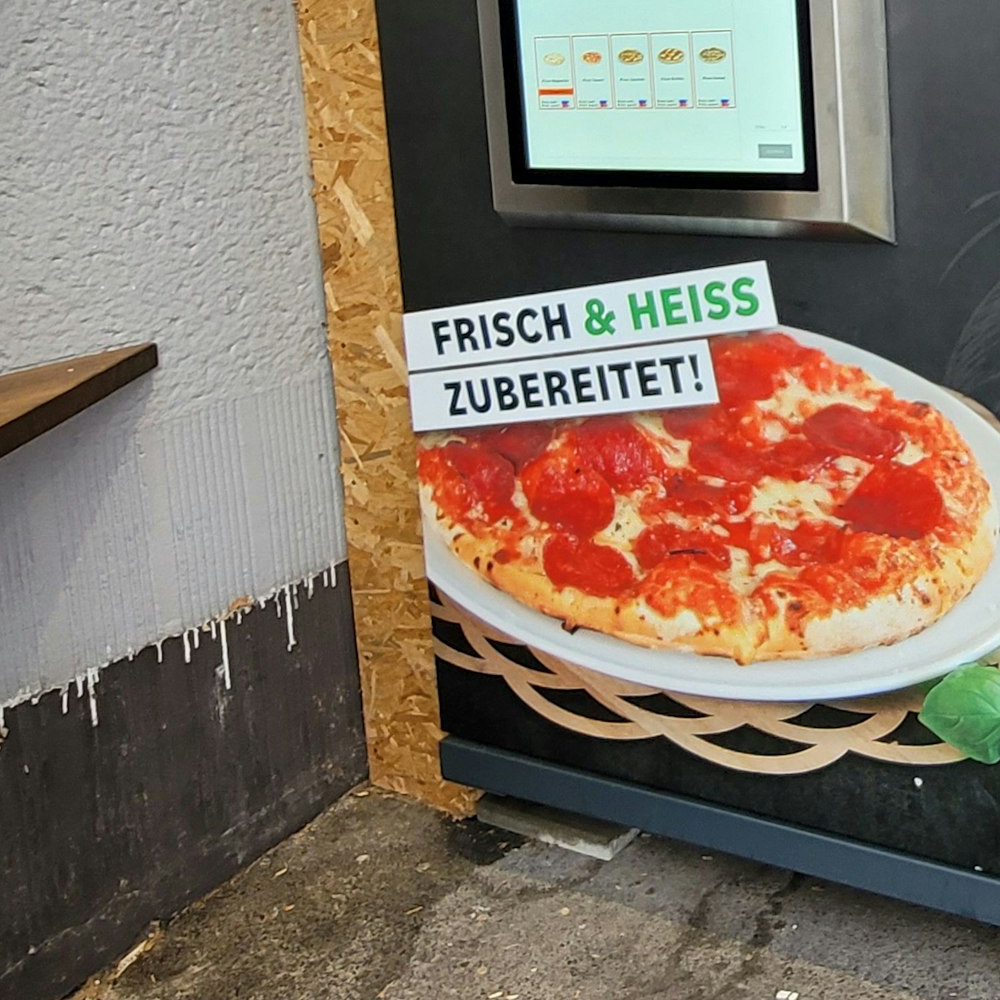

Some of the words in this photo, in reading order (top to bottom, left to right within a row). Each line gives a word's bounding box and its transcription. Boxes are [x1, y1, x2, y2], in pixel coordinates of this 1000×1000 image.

[432, 303, 571, 355] FRISCH
[584, 298, 616, 336] &
[628, 277, 760, 330] HEISS
[444, 354, 703, 416] ZUBEREITET!
